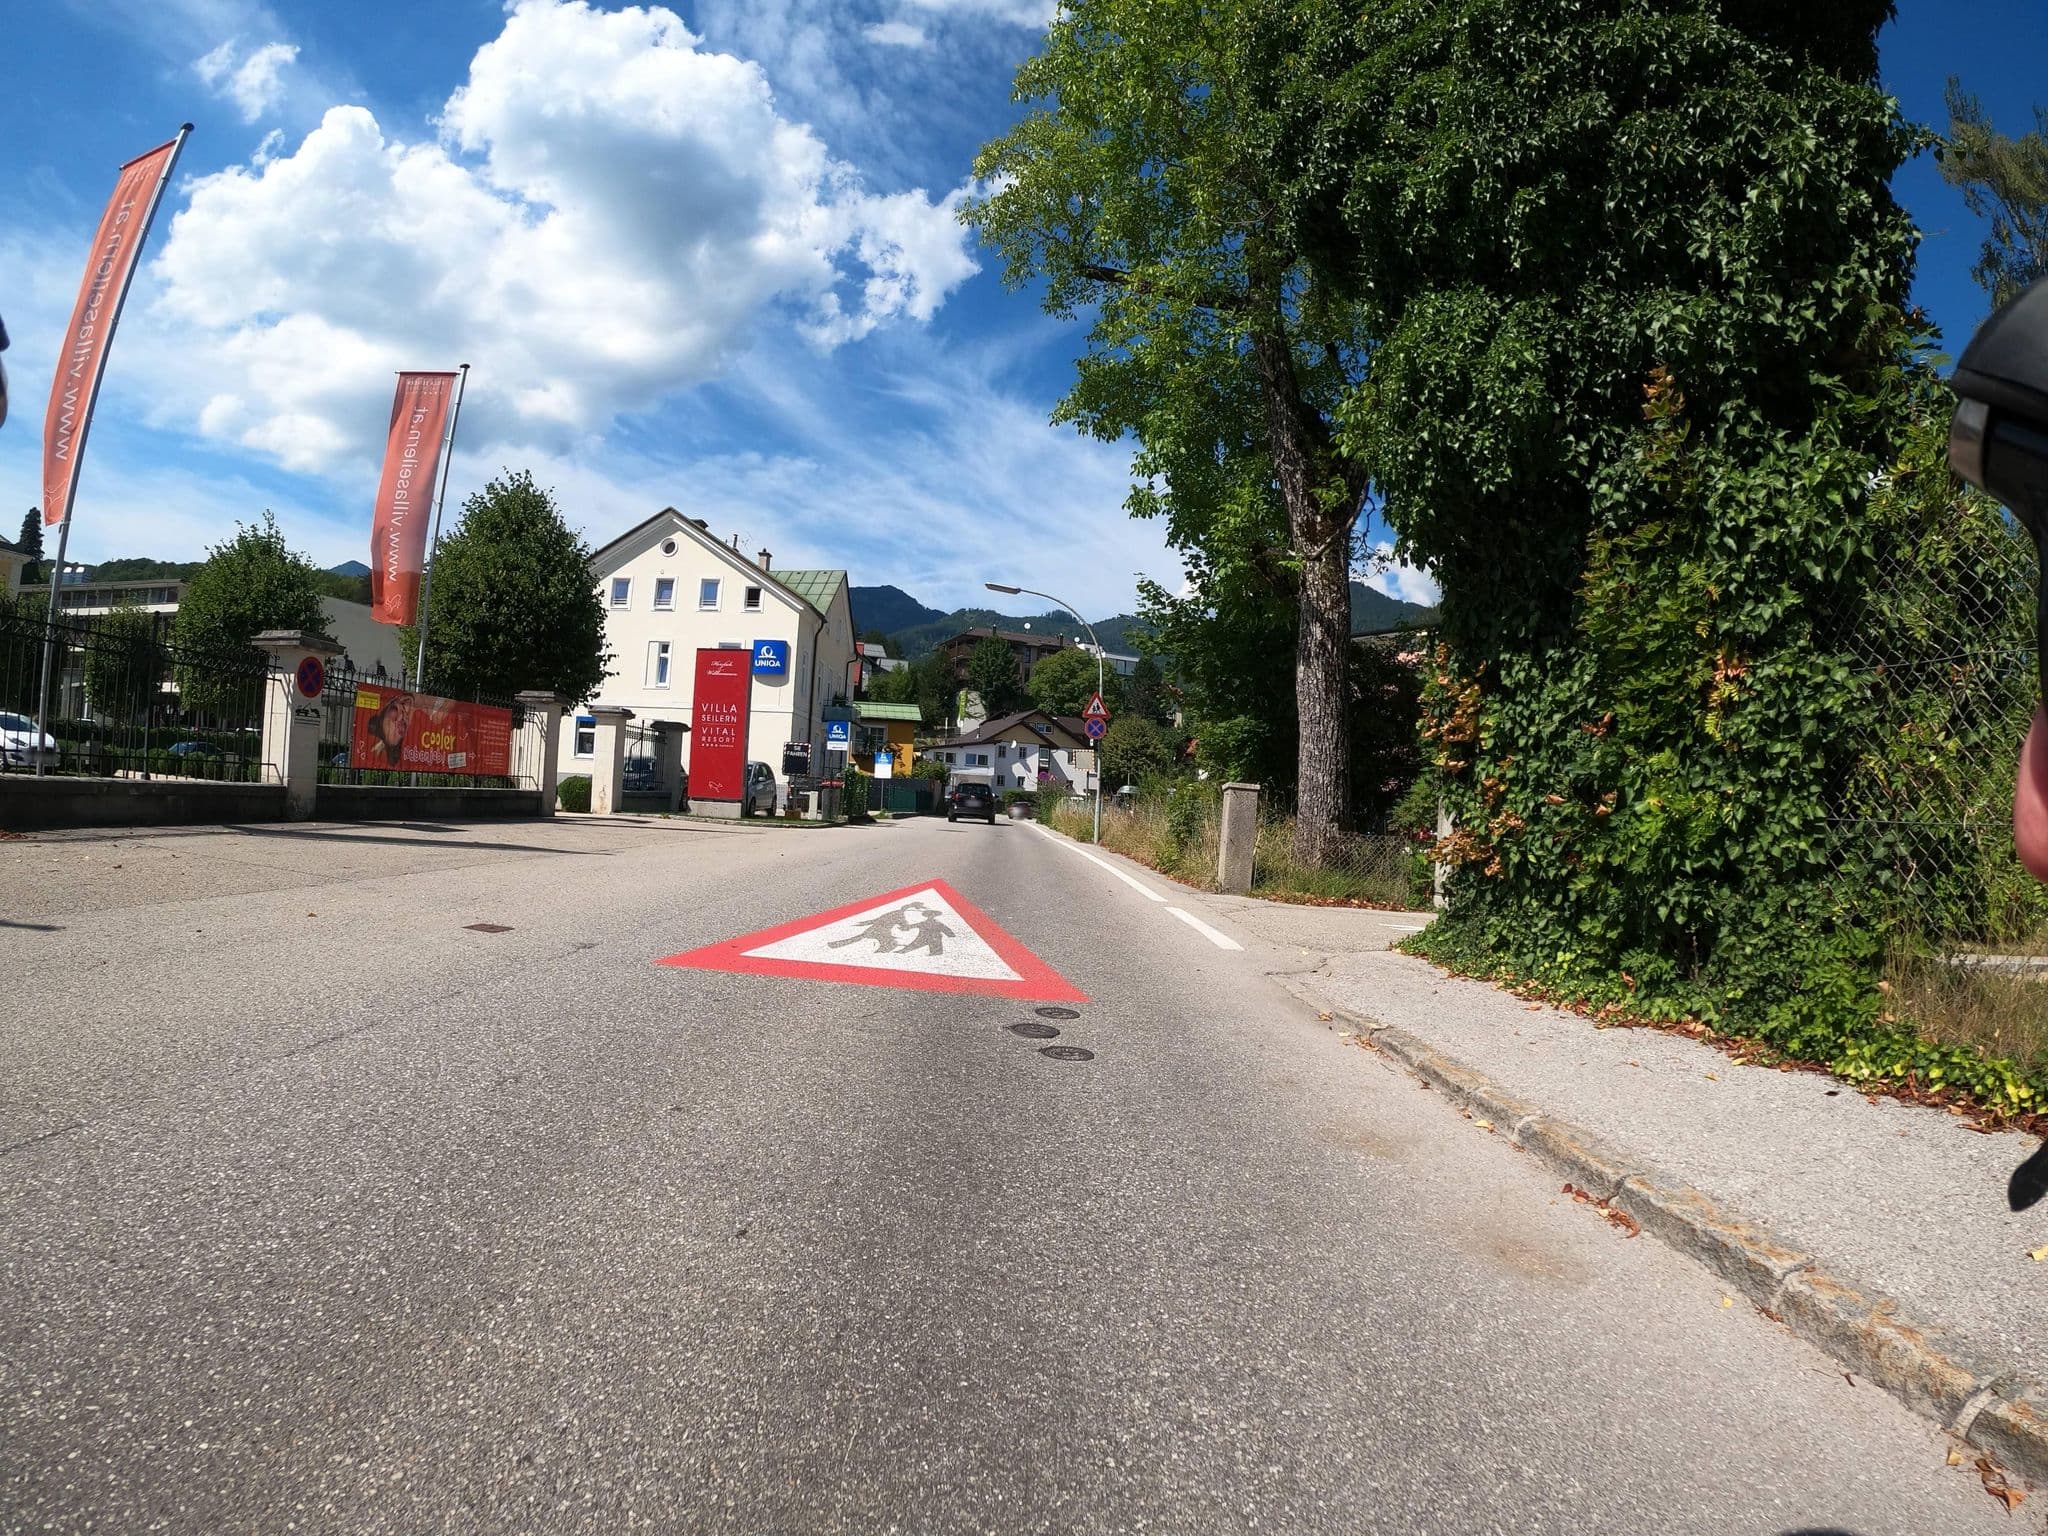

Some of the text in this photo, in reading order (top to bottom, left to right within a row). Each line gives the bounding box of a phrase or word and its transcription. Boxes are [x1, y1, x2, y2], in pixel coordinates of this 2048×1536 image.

[701, 703, 738, 713] VILLA
[701, 714, 737, 723] SEILERN
[701, 727, 736, 736] VITAL
